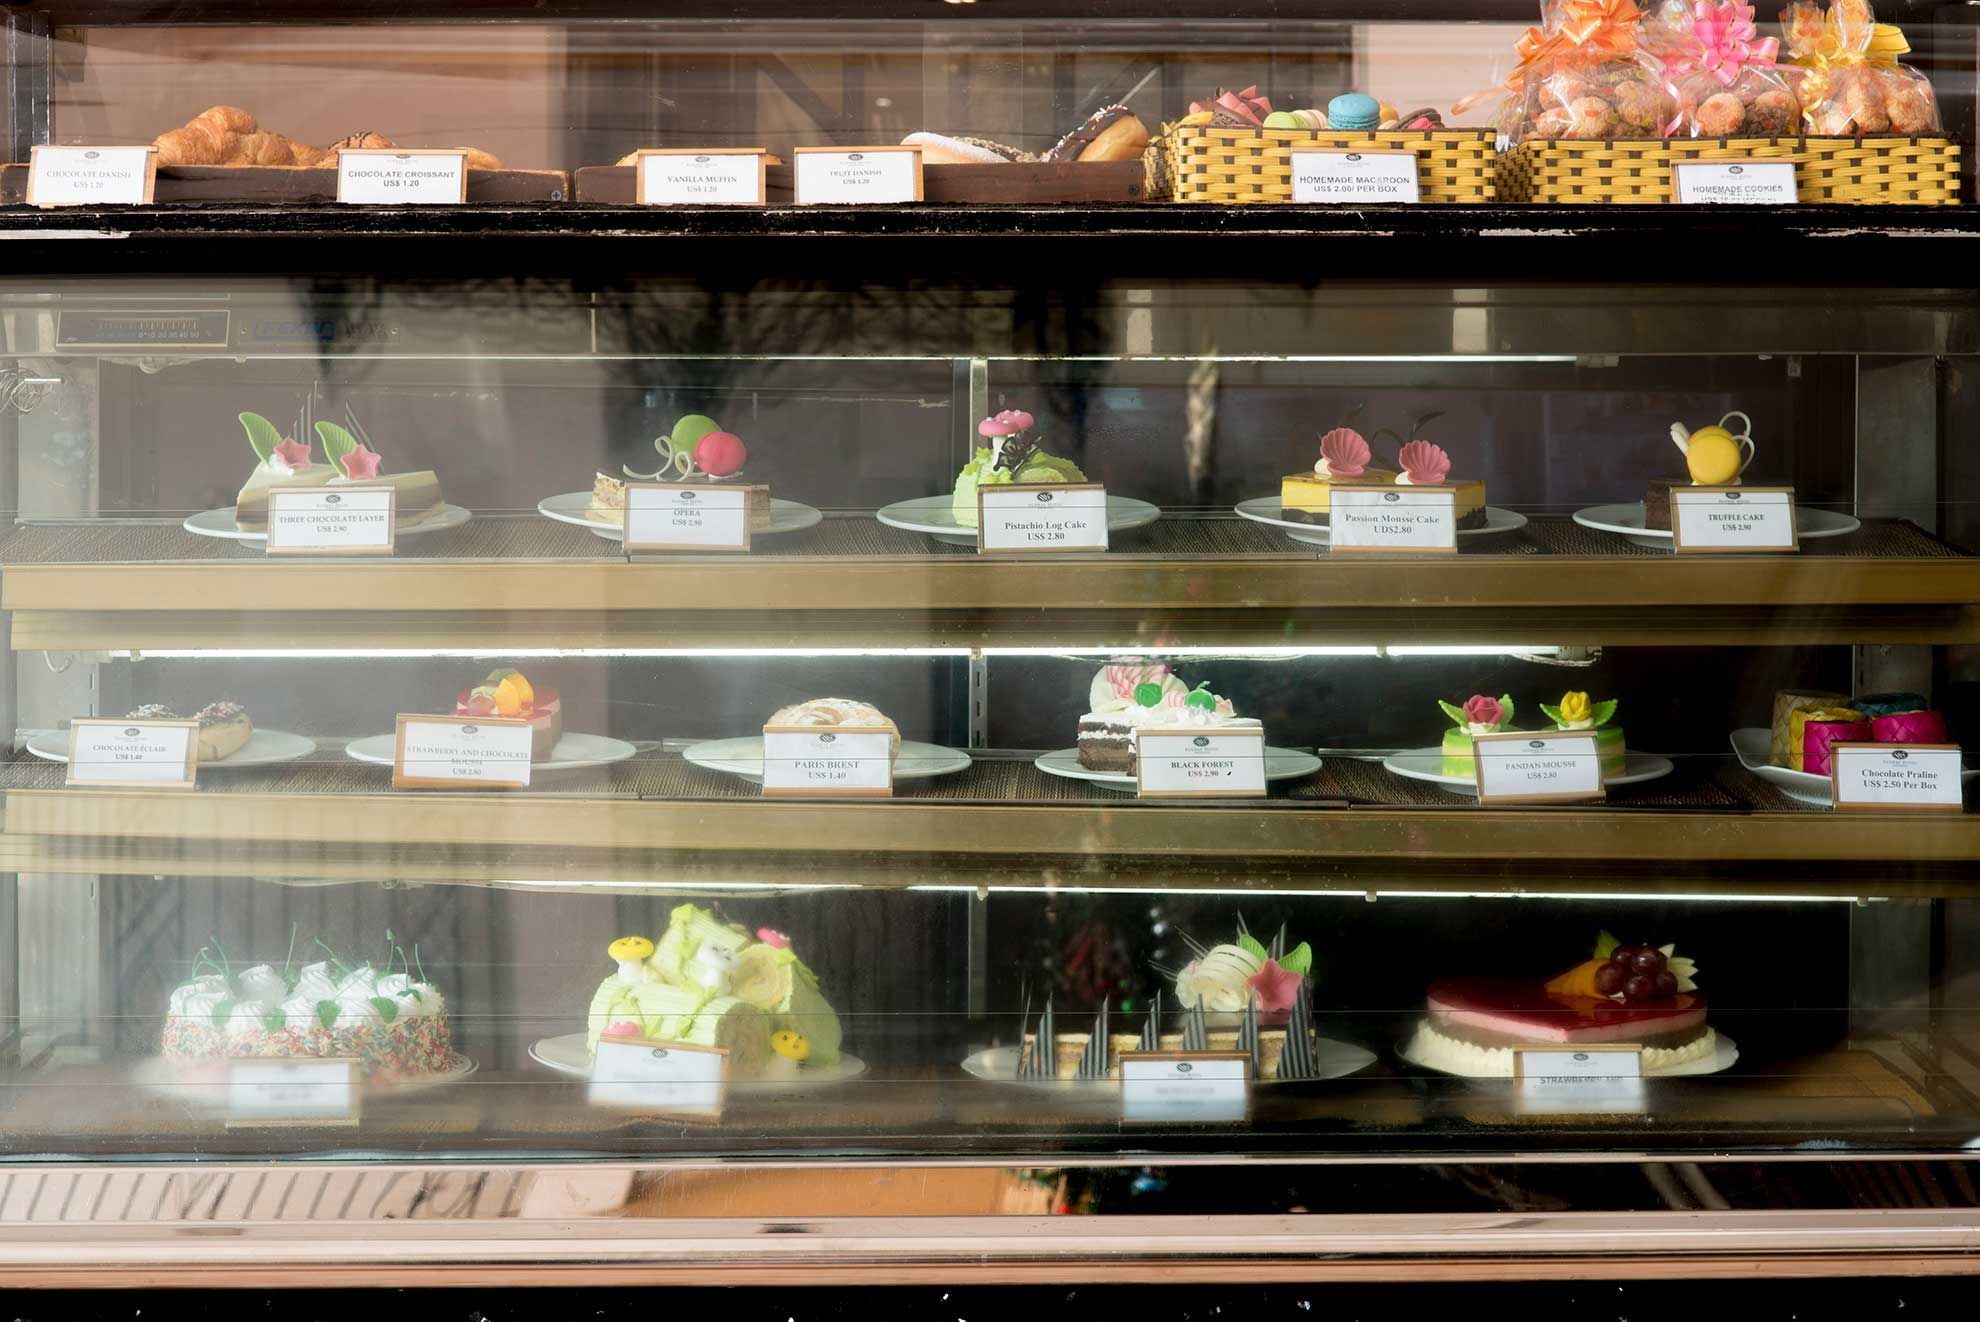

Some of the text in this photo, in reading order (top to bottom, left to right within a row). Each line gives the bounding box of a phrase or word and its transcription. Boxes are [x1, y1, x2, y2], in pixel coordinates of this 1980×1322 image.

[47, 170, 97, 178] CHOCOLATE
[1693, 186, 1742, 194] HOMEMADE
[674, 509, 701, 517] OPERA
[306, 515, 357, 523] CHOCOLATE
[1345, 514, 1378, 522] Passion
[1381, 515, 1414, 523] Mousse
[1005, 520, 1087, 530] Pistachio Log Cake
[1027, 532, 1065, 540] US$ 2.80
[480, 750, 528, 759] CHOCOLATE
[794, 760, 825, 768] PARIS
[1542, 760, 1576, 768] MOUSSE
[829, 772, 846, 780] 1.40
[1861, 769, 1938, 779] Chocolate Praline
[1863, 780, 1881, 788] US$
[1883, 780, 1901, 788] 2.50
[1903, 781, 1918, 789] Per
